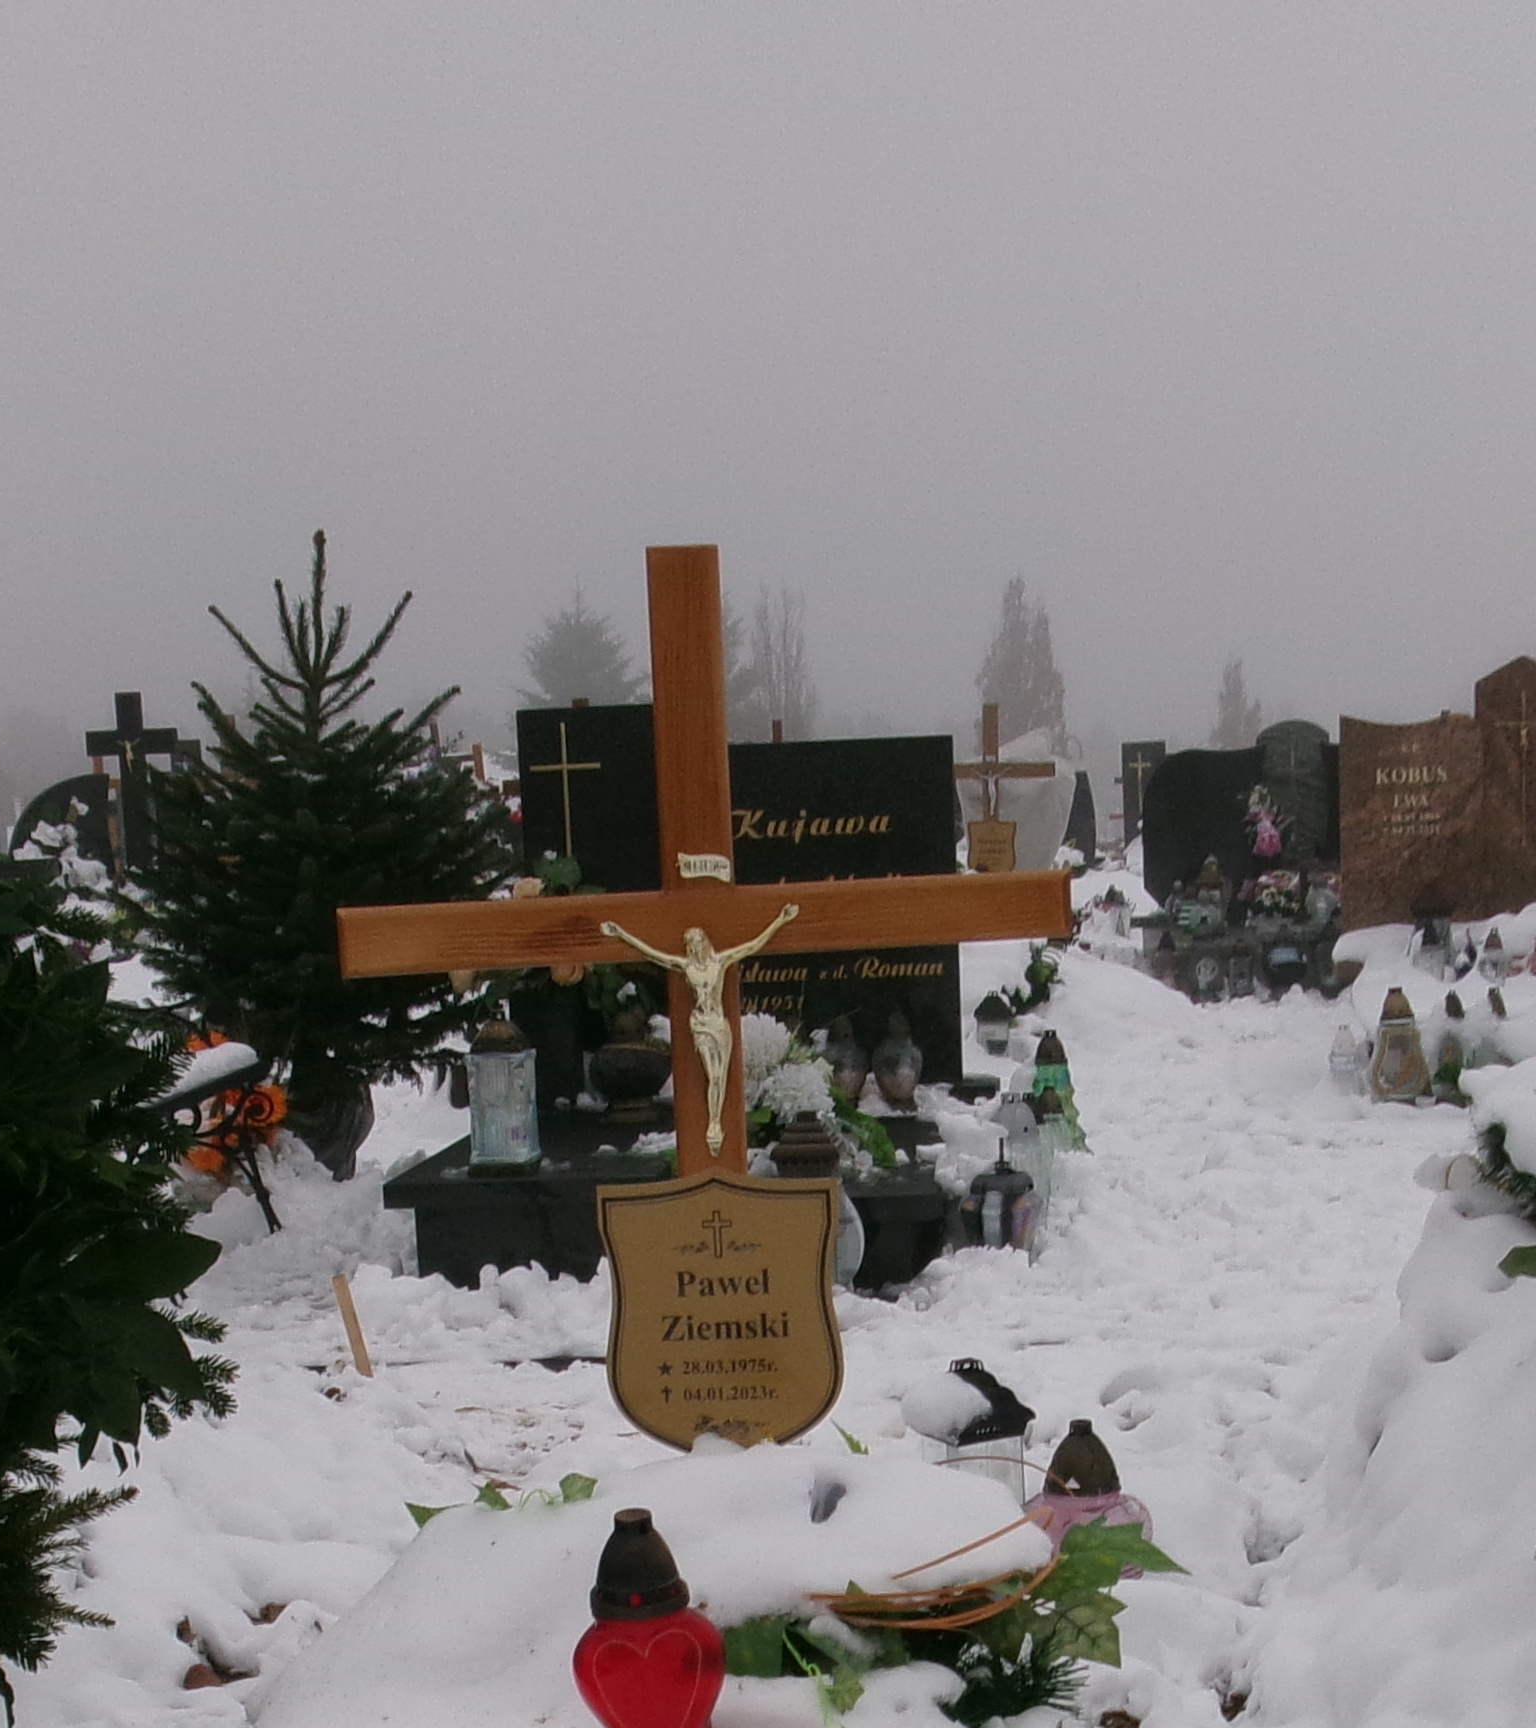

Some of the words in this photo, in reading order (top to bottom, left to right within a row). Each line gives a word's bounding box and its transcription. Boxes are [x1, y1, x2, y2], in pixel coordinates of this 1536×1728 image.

[1375, 765, 1447, 785] KOBUS
[731, 809, 892, 844] Kujawa
[853, 956, 945, 979] Roman
[662, 1312, 790, 1342] Ziemski
